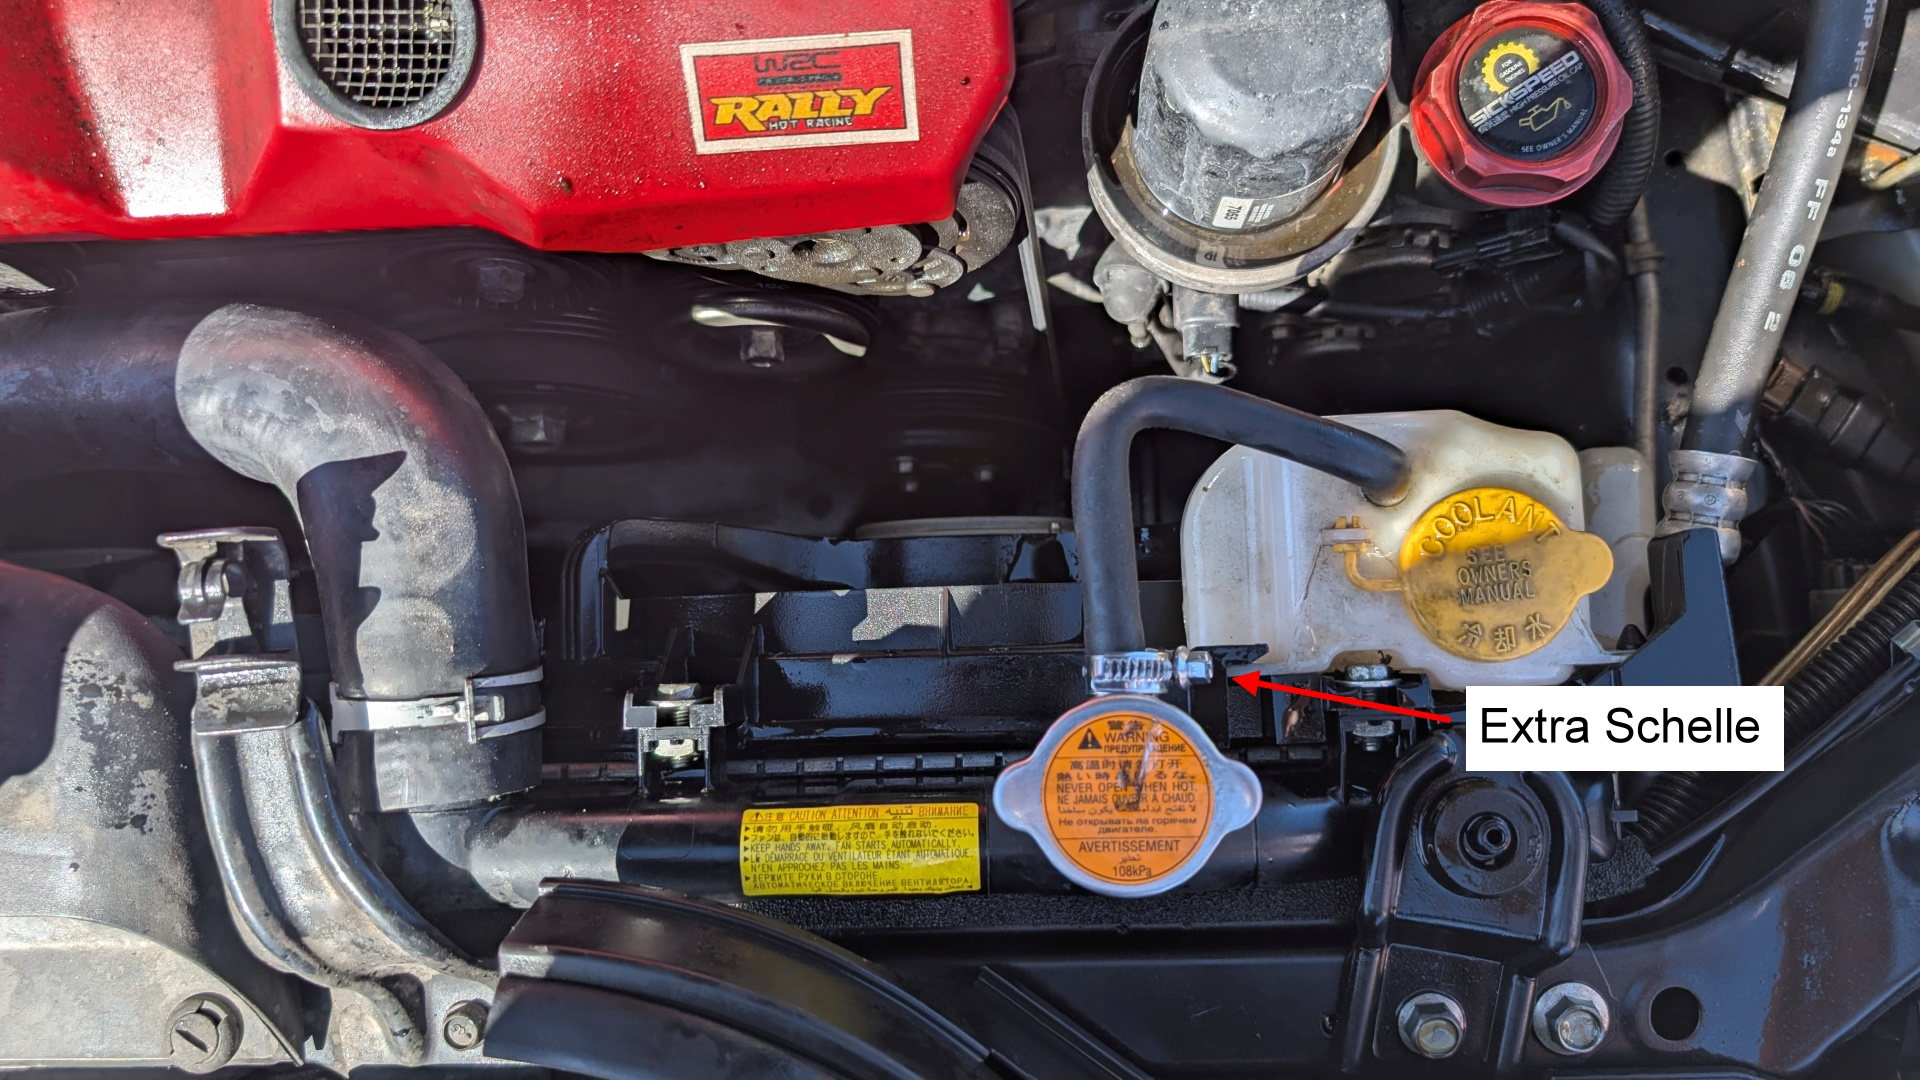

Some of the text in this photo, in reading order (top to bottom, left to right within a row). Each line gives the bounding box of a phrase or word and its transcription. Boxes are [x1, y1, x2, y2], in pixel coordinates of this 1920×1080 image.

[1498, 60, 1523, 79] GASOLINE
[1501, 59, 1513, 68] FOR
[1505, 67, 1526, 83] ENGINES
[1468, 50, 1580, 127] SICKSPEED
[1509, 62, 1583, 113] HIGH PRESSURE OIL CAP
[710, 86, 894, 132] RALLY
[768, 119, 798, 131] HOT
[1521, 145, 1534, 153] SEE
[1566, 108, 1589, 134] MANUAL
[1807, 178, 1829, 221] FF
[1763, 310, 1782, 333] 2
[1420, 495, 1561, 558] COOLANT
[1466, 544, 1505, 564] SEE
[1457, 560, 1532, 586] OWNERS
[1458, 580, 1536, 607] MANUAL
[1457, 612, 1551, 652] 冷却水
[1103, 731, 1170, 743] WARNNG
[1103, 743, 1187, 754] ПРЕДУПРДЕНИЕ
[1056, 782, 1093, 793] NEVER
[1098, 782, 1128, 793] OPEN
[1133, 781, 1167, 792] HEN
[1056, 794, 1071, 805] NE
[1073, 794, 1107, 805] JAMAIS
[789, 809, 827, 821] CAUTION
[831, 807, 880, 819] ATTENTION
[918, 805, 969, 817] ВНИМАНИЕ
[750, 843, 771, 853] KEEP
[775, 842, 801, 852] HANDS
[835, 840, 852, 850] FAN
[855, 840, 886, 850] STARTS
[1078, 839, 1181, 853] AVERTISSEMENT
[764, 851, 808, 863] DÉMARRAGE
[813, 852, 824, 861] DU
[828, 850, 882, 861] VENTILATEUR
[886, 848, 911, 859] ÉTANT
[750, 863, 773, 873] N'EN
[777, 862, 825, 872] APPROCHEZ
[830, 861, 847, 871] PAS
[851, 861, 868, 870] LES
[1113, 865, 1153, 877] 108kPa
[798, 872, 822, 881] РУКИ
